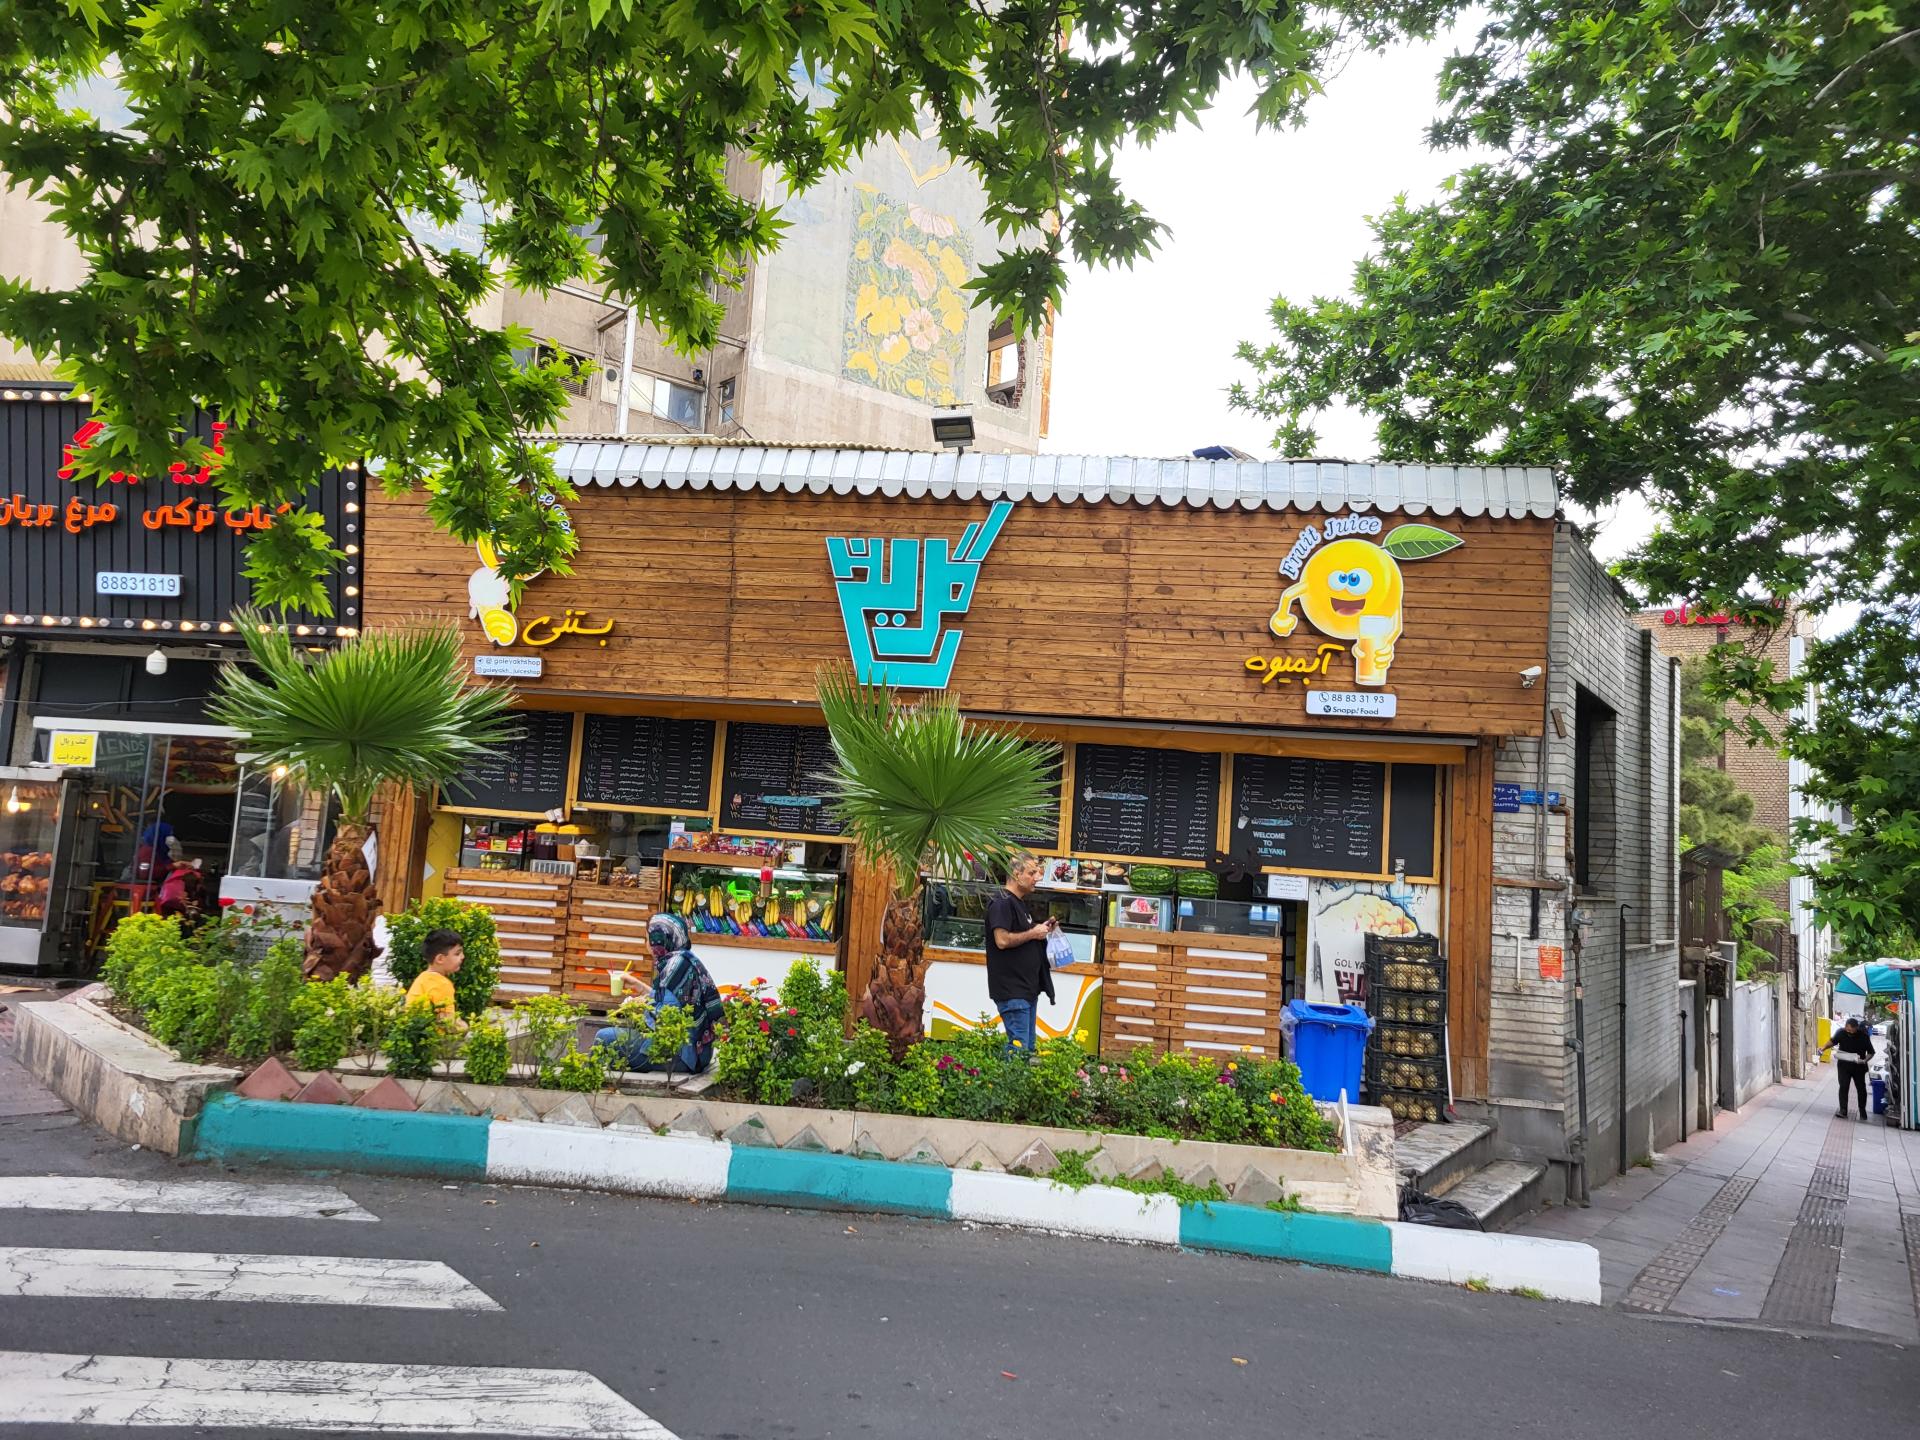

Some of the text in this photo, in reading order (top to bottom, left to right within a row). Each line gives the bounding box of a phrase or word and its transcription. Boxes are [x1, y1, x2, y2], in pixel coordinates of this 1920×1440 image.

[64, 495, 118, 534] مرغ
[142, 496, 216, 533] ترکی
[1281, 514, 1380, 578] Fruit Juice
[100, 575, 176, 592] 88831819
[522, 608, 615, 647] بستنی
[1244, 642, 1346, 686] آبمیوه
[1331, 693, 1385, 704] 88 83 31 93
[1360, 707, 1379, 715] Food
[1252, 830, 1286, 840] WELCOME
[1334, 958, 1353, 969] GOL
